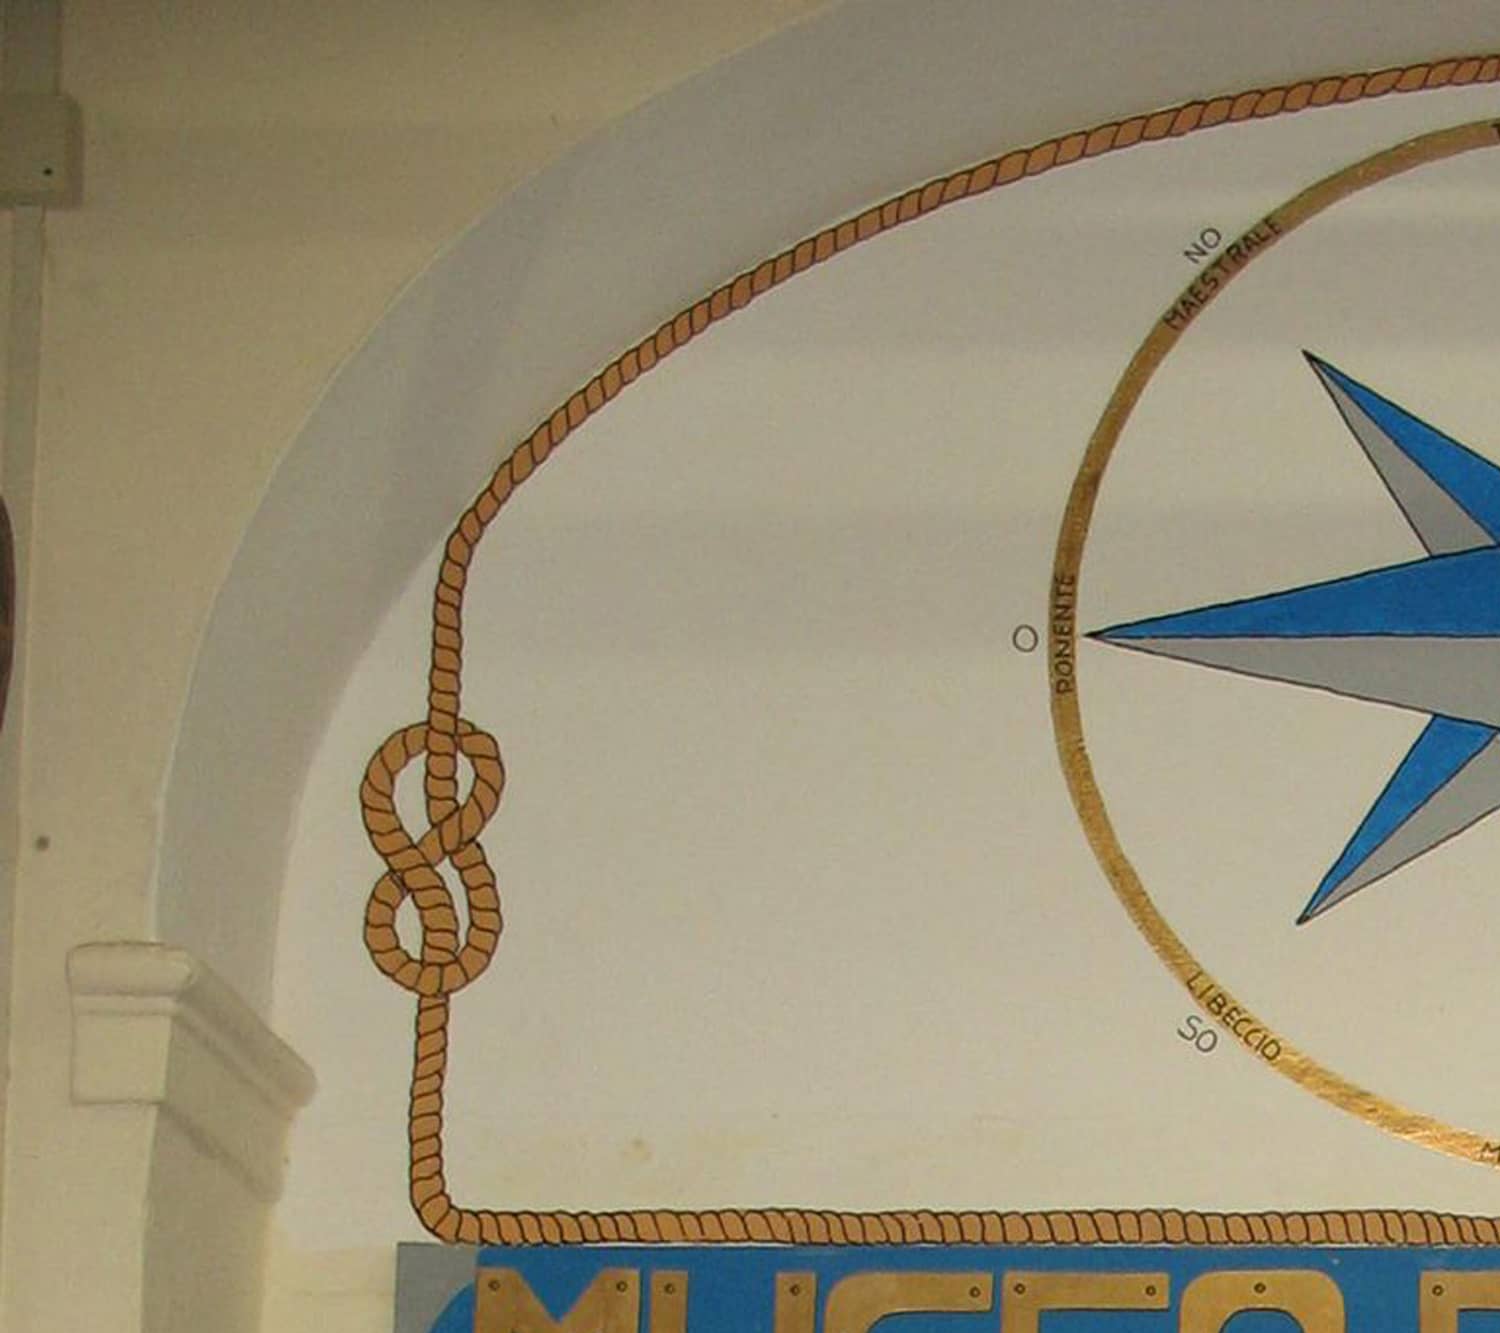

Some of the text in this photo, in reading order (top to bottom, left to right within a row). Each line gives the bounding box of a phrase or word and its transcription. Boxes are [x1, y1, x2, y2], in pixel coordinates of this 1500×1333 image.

[1162, 217, 1283, 332] MAESTRALE
[1184, 227, 1222, 264] NO
[1012, 623, 1039, 653] O
[1052, 573, 1075, 694] PONENTE
[1177, 1015, 1218, 1053] SO
[1186, 970, 1281, 1061] LIBECCIO
